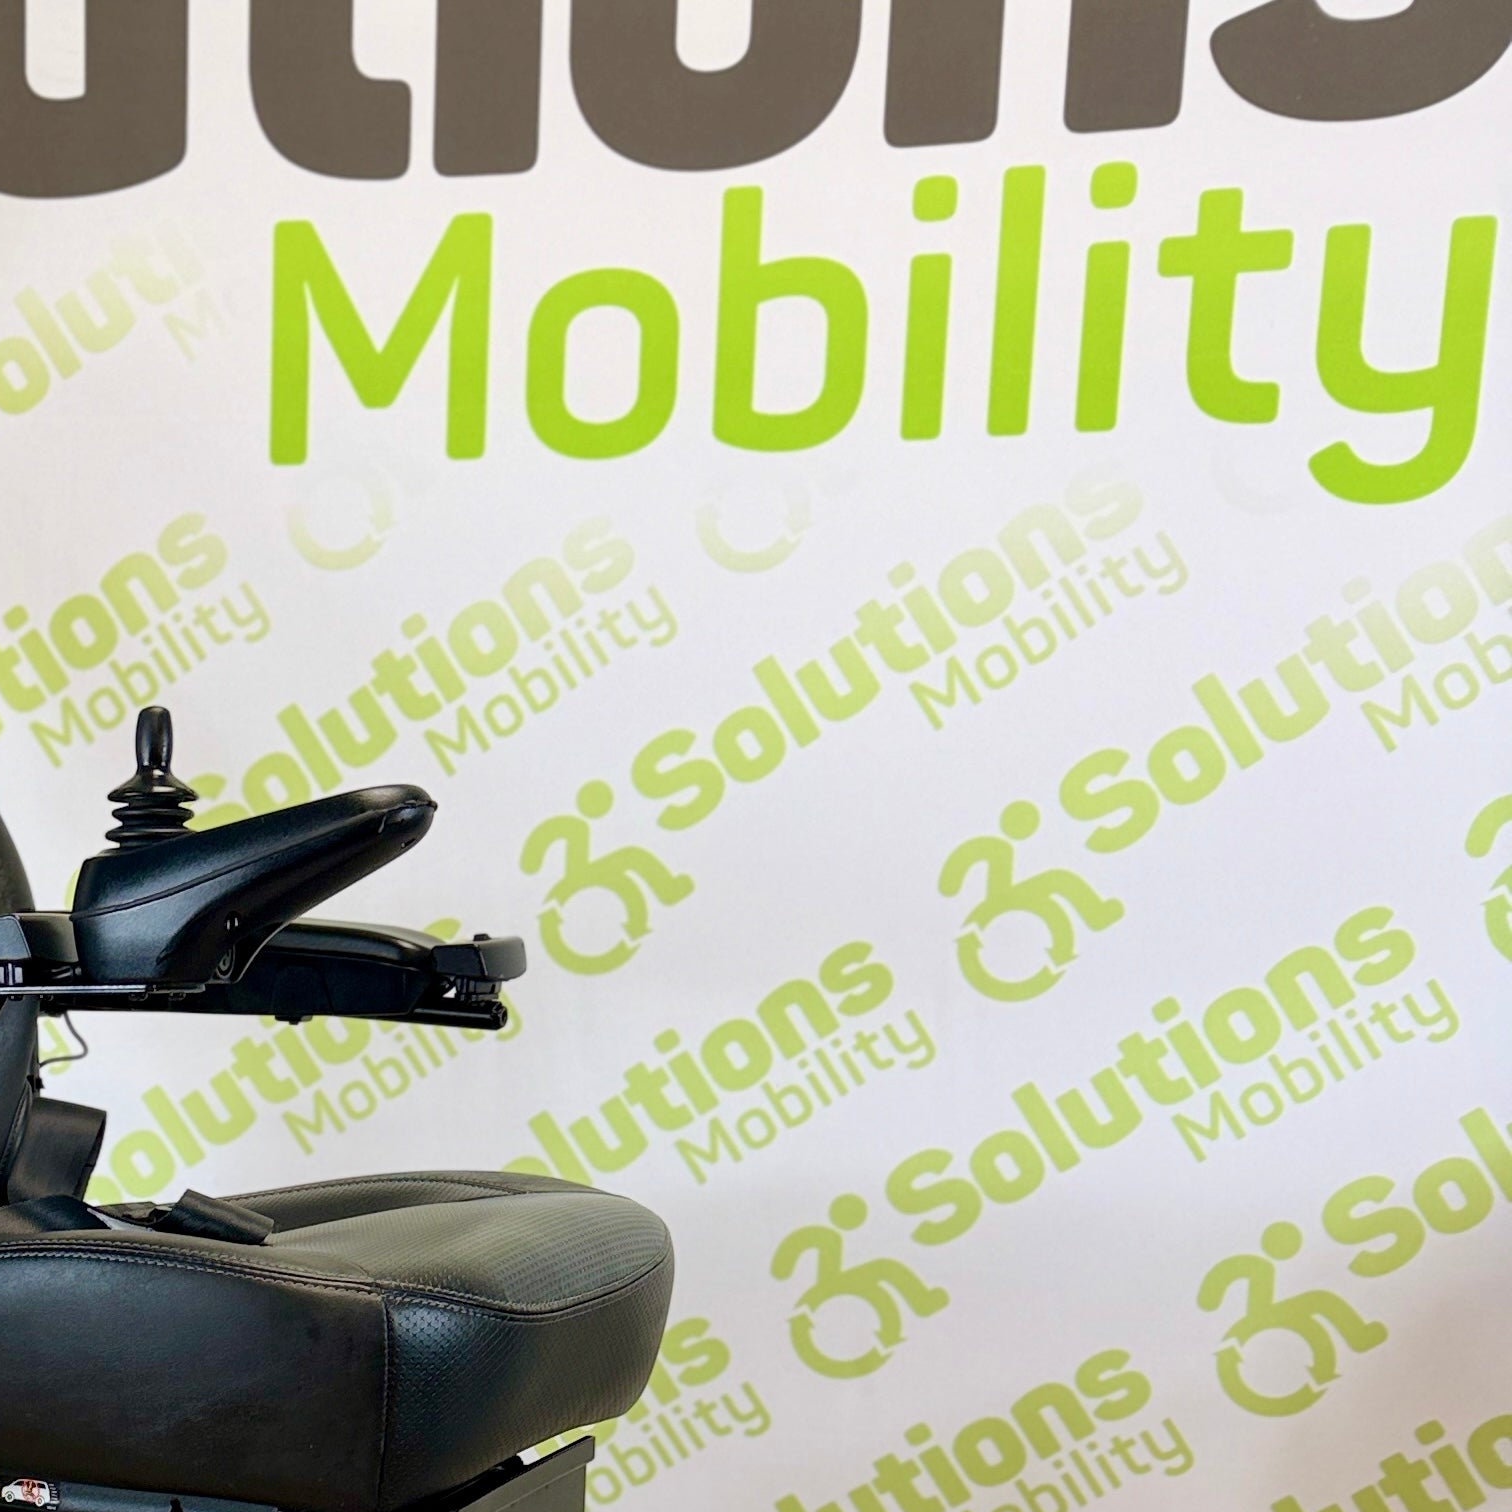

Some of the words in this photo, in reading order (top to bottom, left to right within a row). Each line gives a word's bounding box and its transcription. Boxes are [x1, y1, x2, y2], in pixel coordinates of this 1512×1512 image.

[270, 161, 1497, 504] Mobility
[28, 580, 271, 769] Mobility
[423, 583, 678, 777] Mobility
[908, 531, 1189, 730] Mobility
[674, 1009, 936, 1185] Mobility
[885, 906, 1416, 1247] Solutions
[1170, 978, 1461, 1165] Mobility
